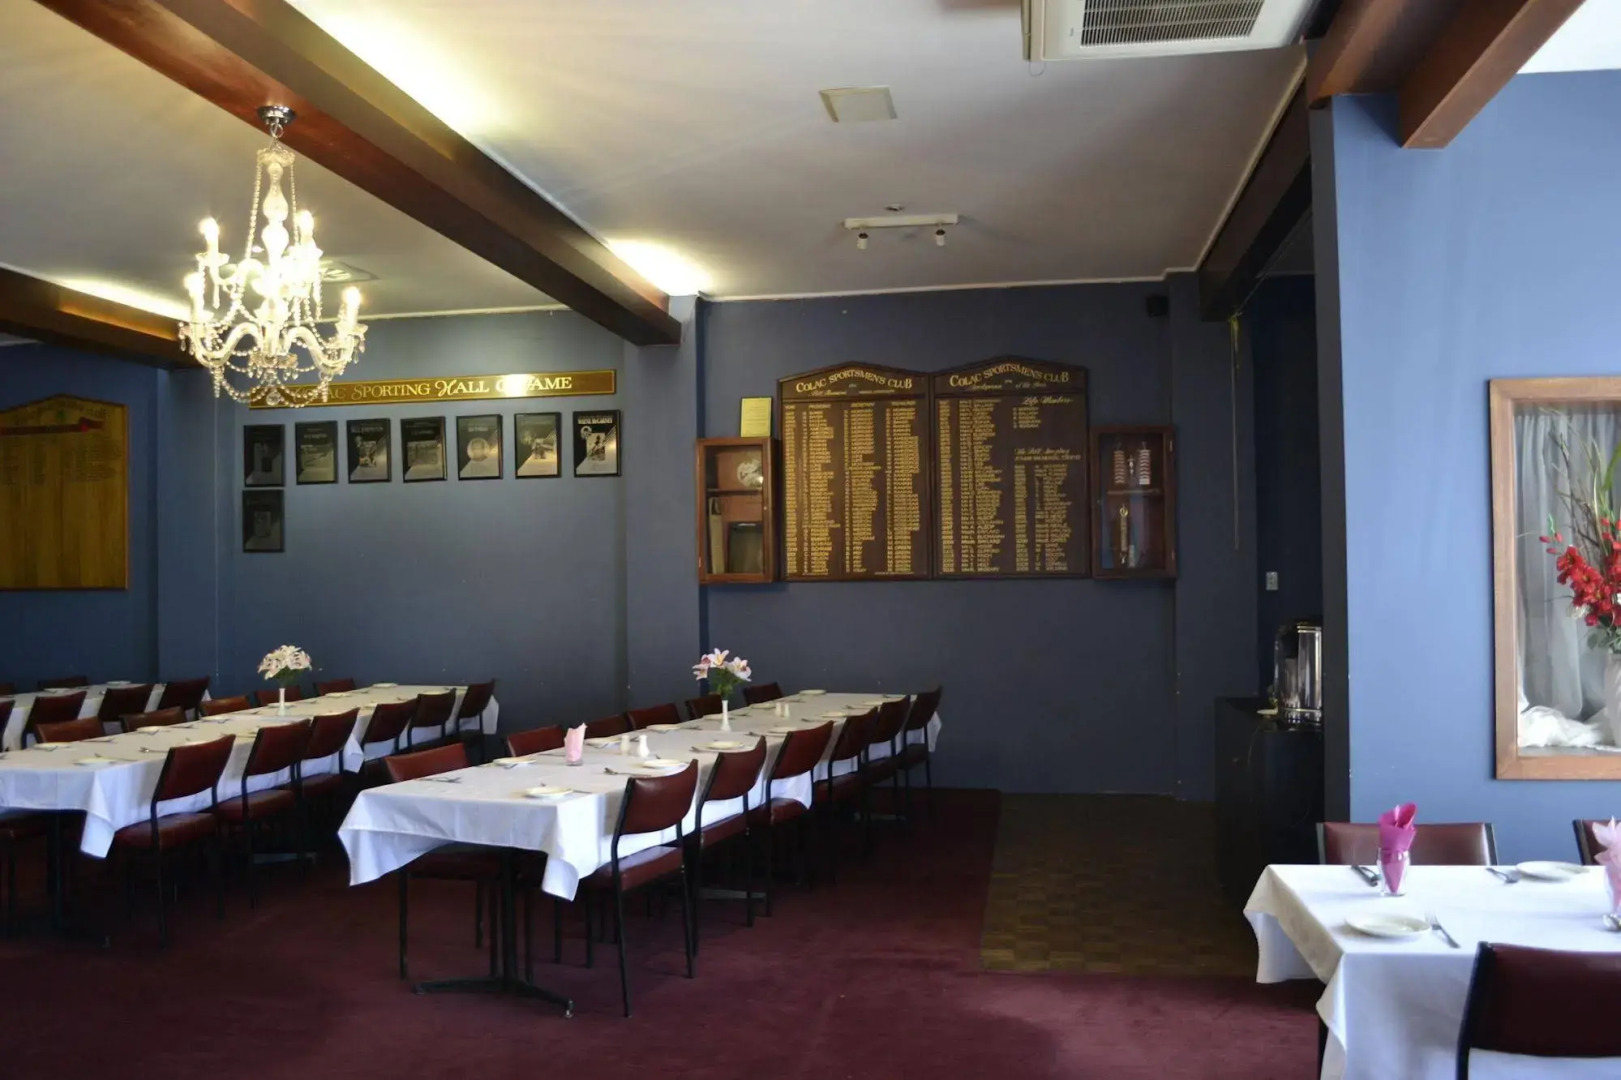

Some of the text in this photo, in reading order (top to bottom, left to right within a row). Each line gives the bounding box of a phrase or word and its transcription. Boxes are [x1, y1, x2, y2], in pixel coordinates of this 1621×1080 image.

[796, 378, 827, 393] COLAC
[888, 377, 913, 389] CLUB
[950, 372, 982, 387] COLAC
[1044, 371, 1070, 383] CLUB
[351, 383, 431, 400] SPORTING
[435, 379, 490, 397] HALL
